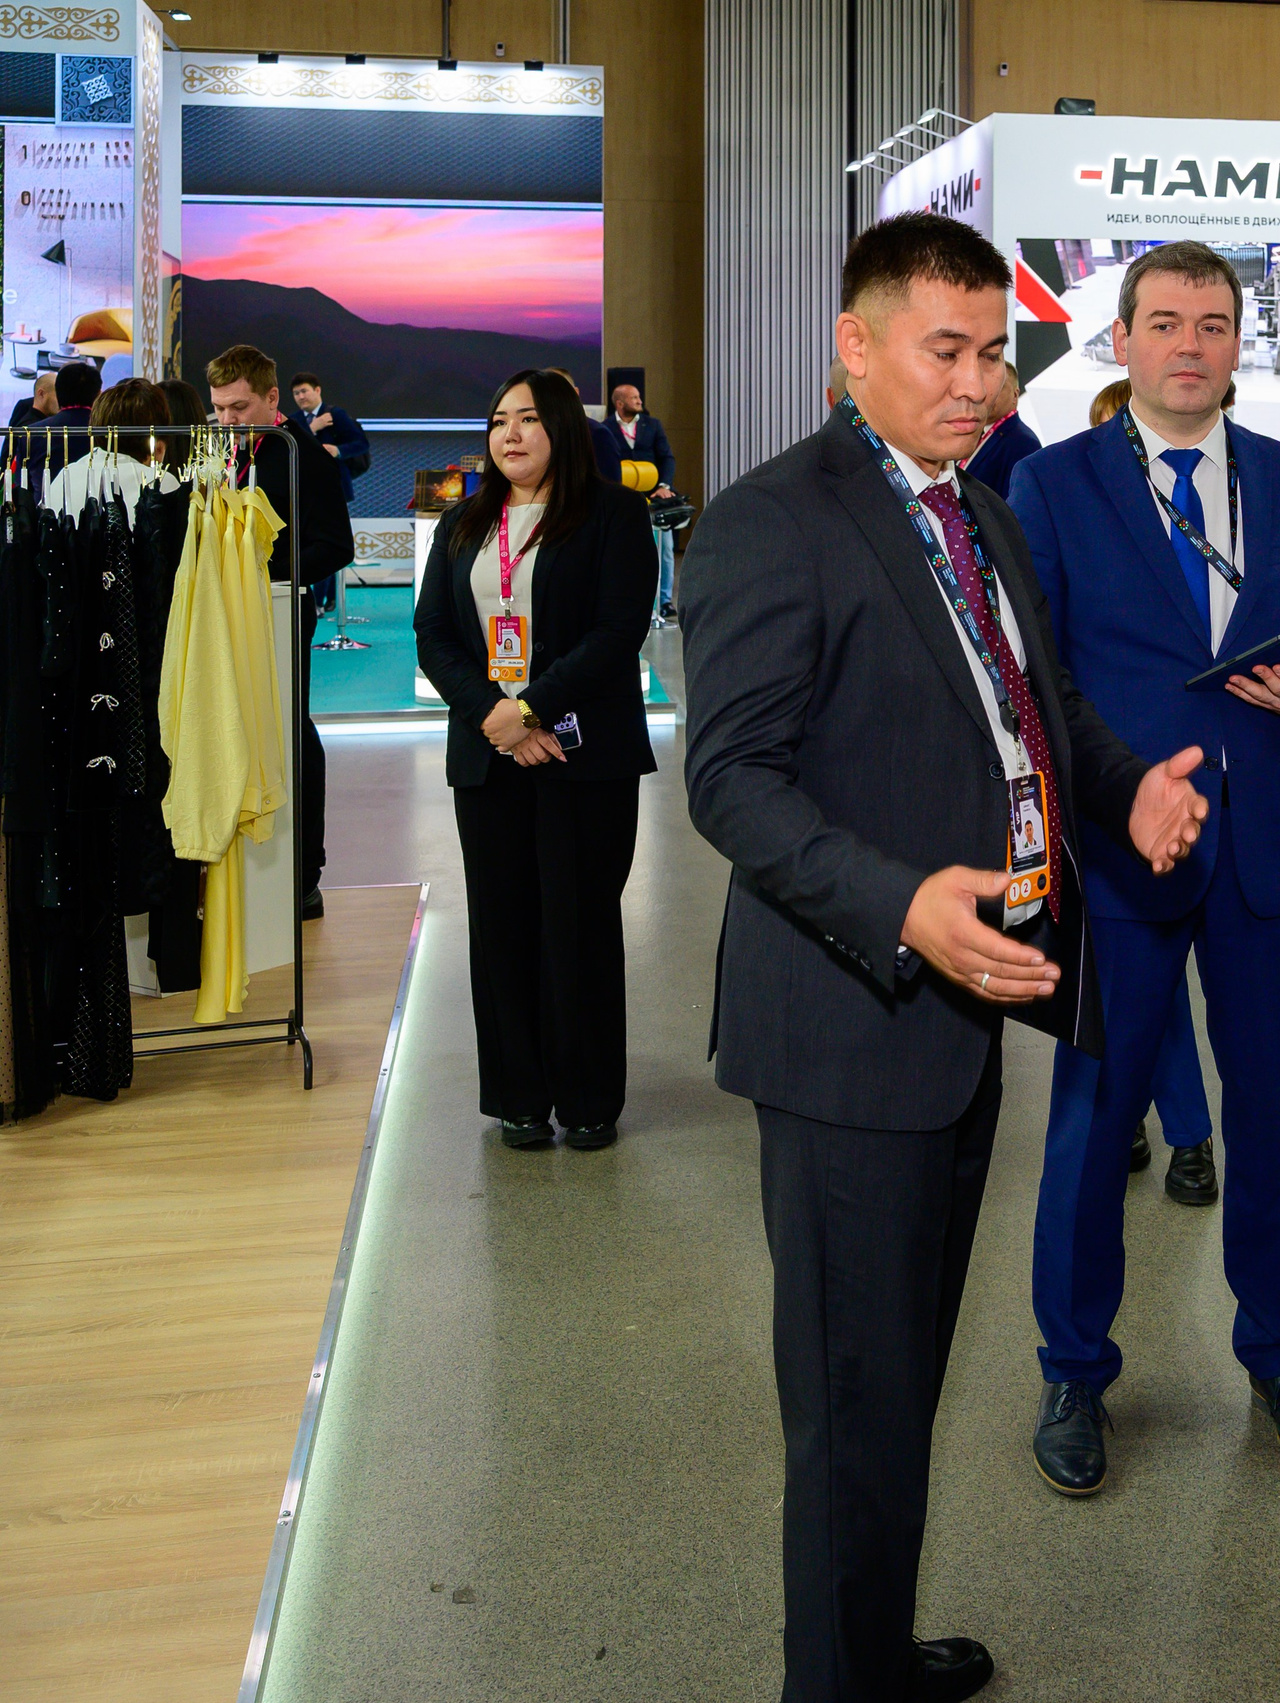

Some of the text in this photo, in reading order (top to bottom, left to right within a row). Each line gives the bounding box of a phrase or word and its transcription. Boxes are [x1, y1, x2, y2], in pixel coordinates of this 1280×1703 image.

[1106, 213, 1143, 225] ИДЕИ,
[1145, 212, 1240, 227] ВОПЛОЩЁННЫЕ
[1243, 216, 1249, 226] В
